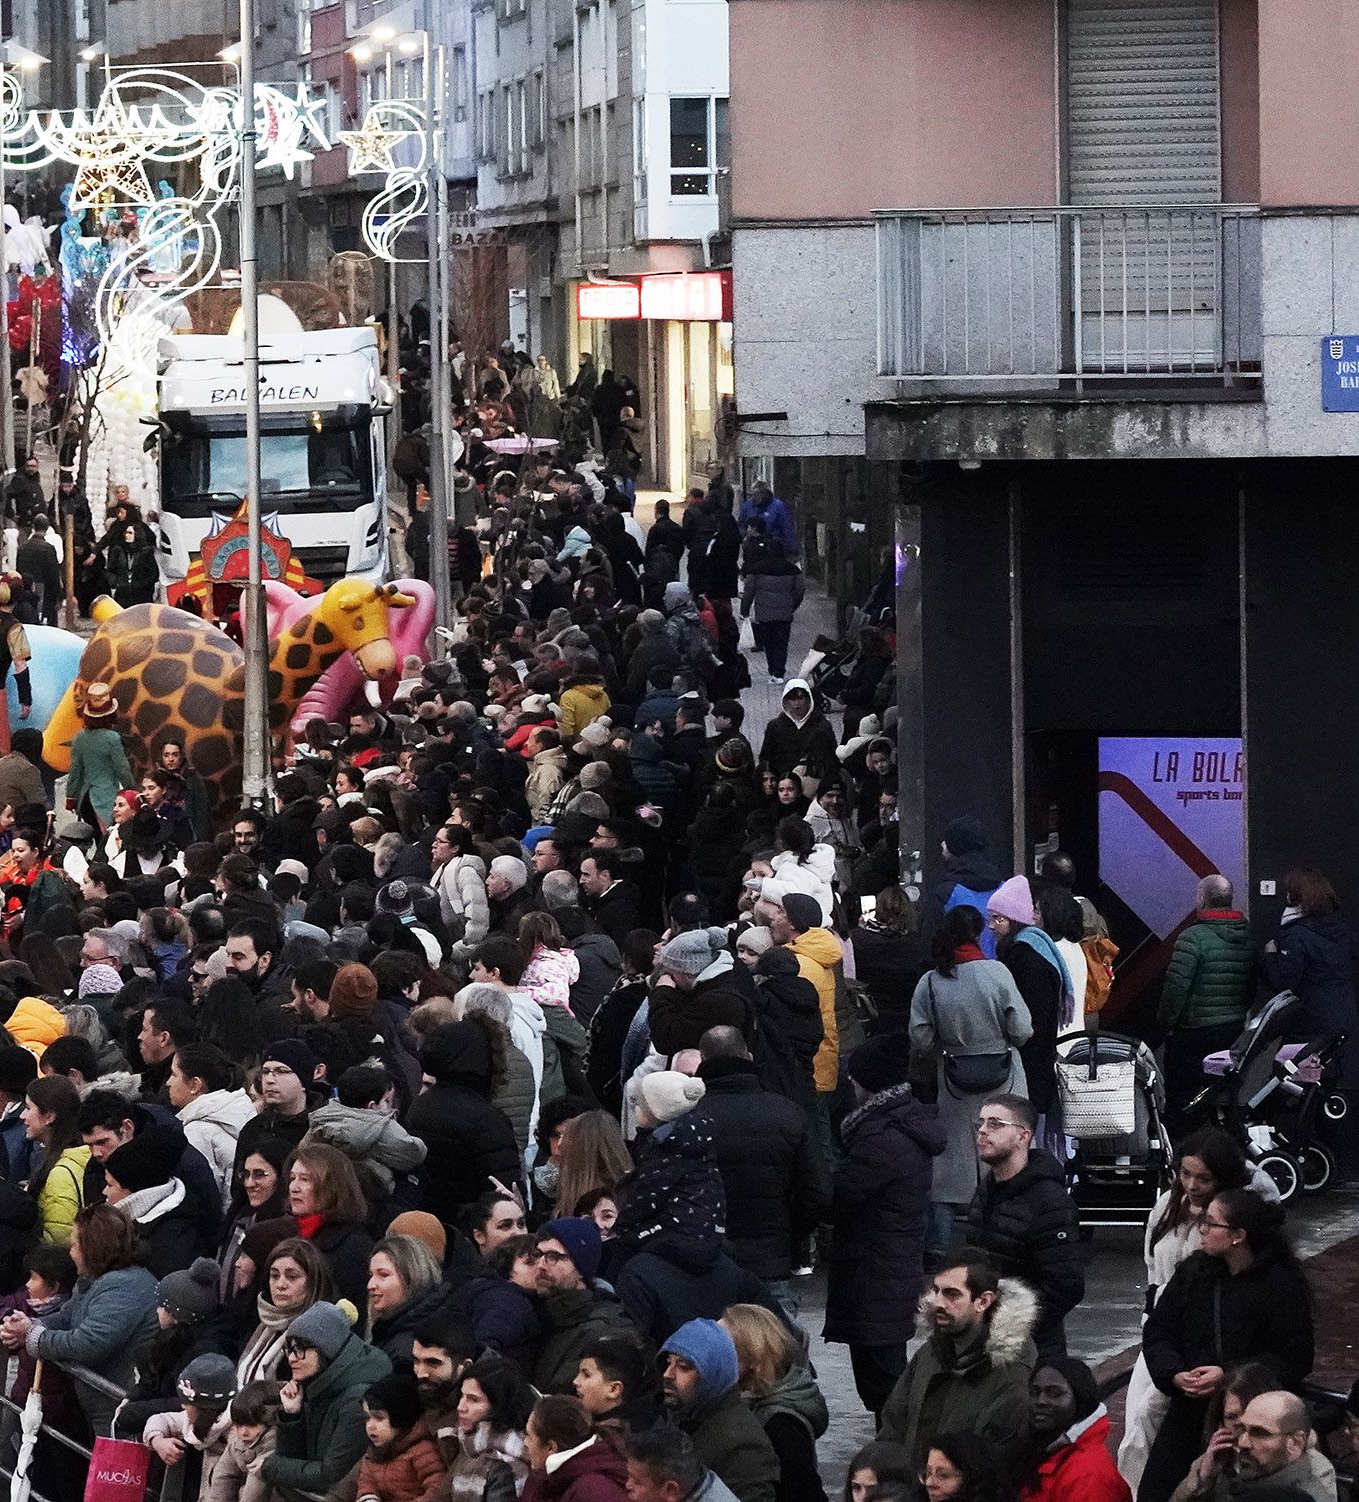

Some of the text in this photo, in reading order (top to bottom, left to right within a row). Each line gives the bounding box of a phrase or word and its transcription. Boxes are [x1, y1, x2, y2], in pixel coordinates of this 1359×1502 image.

[584, 290, 633, 306] FROZ
[210, 385, 319, 403] BALALEN
[1153, 751, 1179, 783] LA
[1176, 790, 1220, 808] sports
